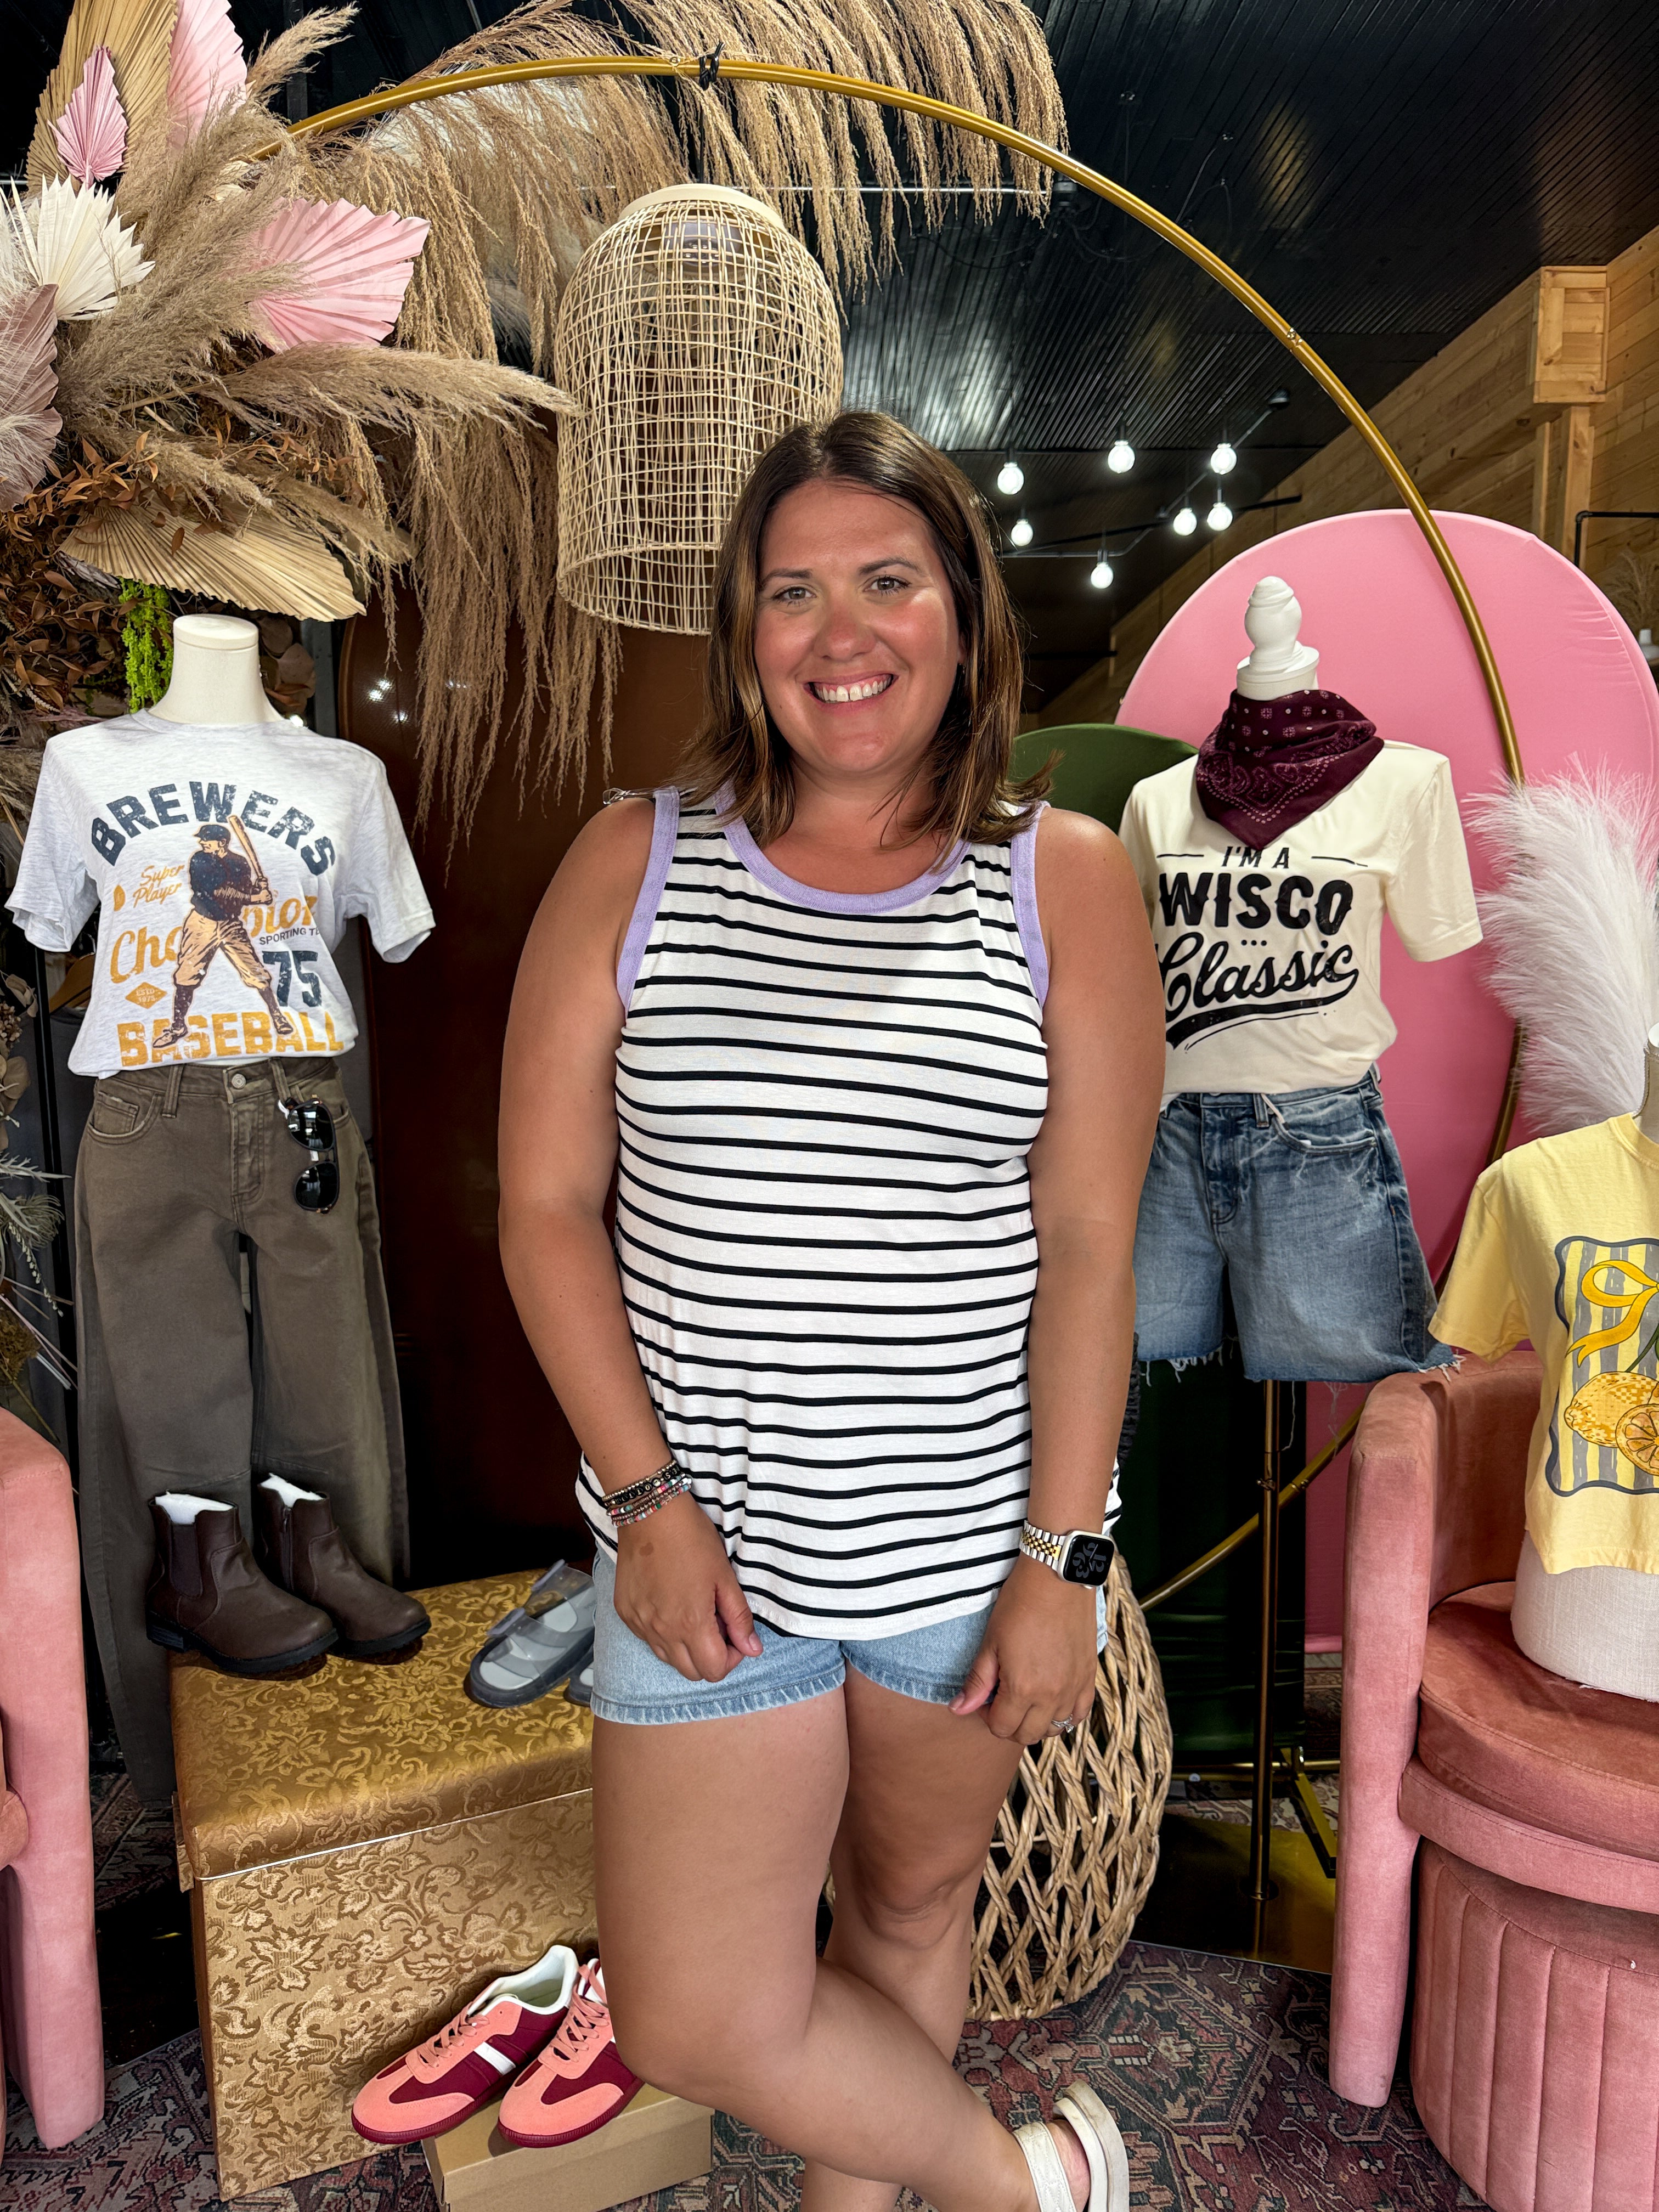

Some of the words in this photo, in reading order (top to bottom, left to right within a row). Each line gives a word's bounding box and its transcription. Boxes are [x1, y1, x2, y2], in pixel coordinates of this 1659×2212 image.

[91, 781, 335, 876] BREWERS
[140, 865, 185, 887] Super
[1221, 846, 1262, 868] I'M
[1272, 847, 1290, 869] A
[133, 883, 182, 908] Player
[1159, 872, 1354, 935] WISCO
[259, 928, 307, 945] SPORTING
[262, 950, 323, 1007] 75
[1155, 932, 1359, 1024] Classic
[117, 1011, 344, 1067] BASEBALL
